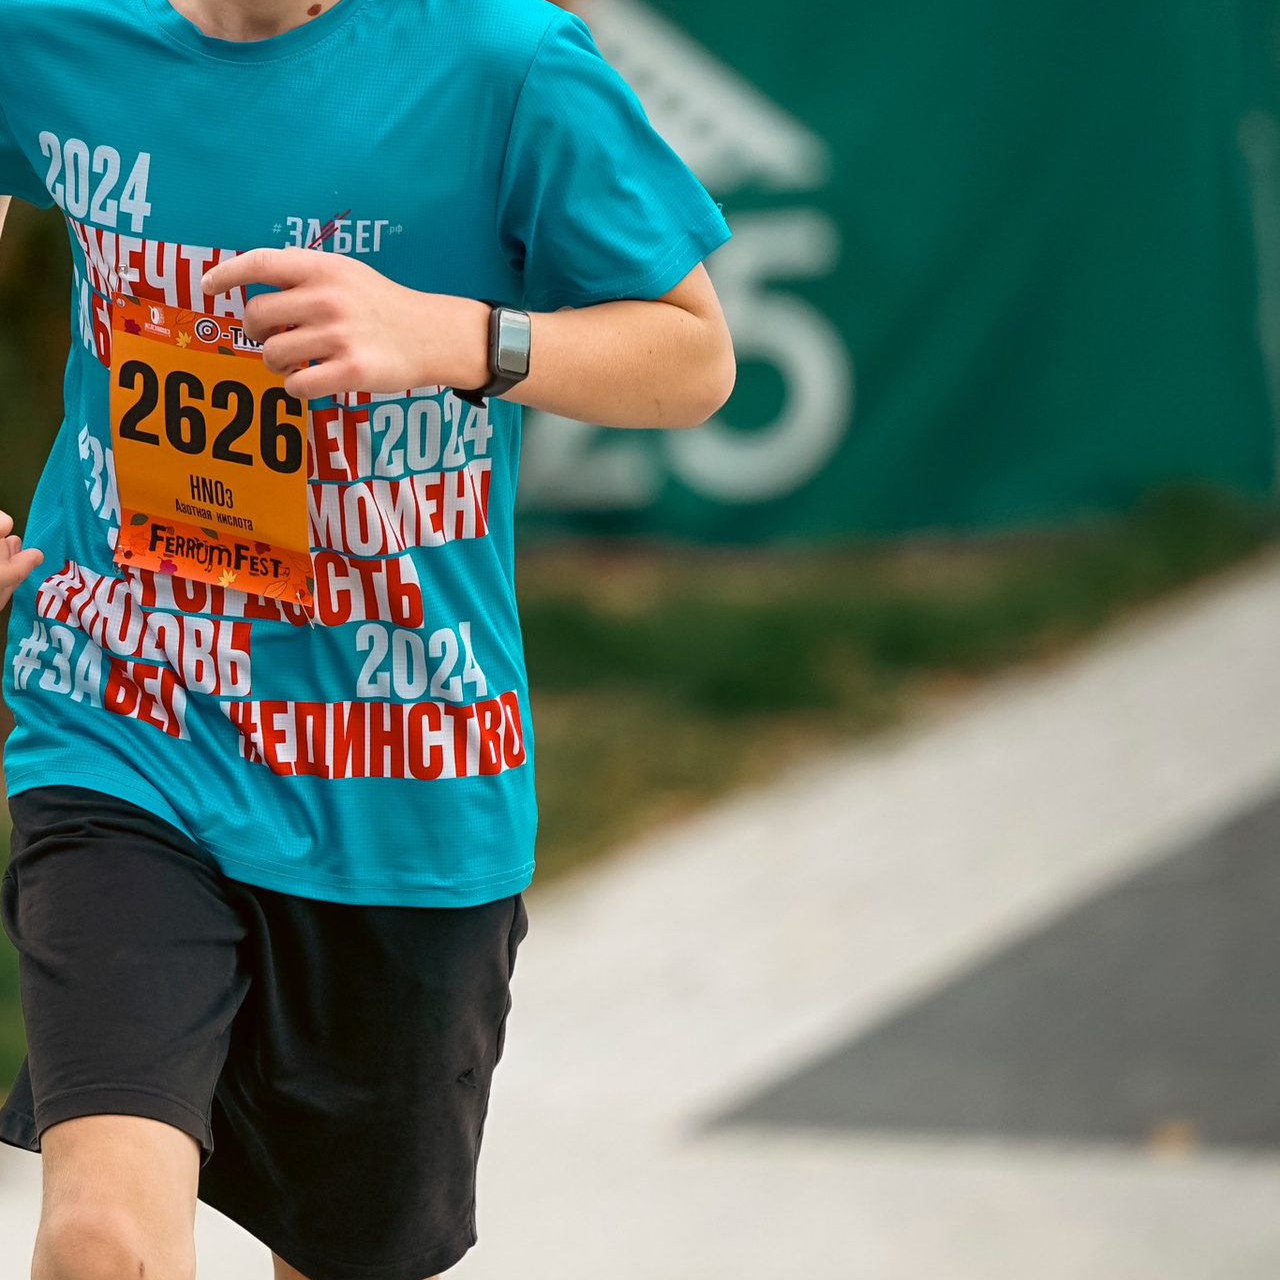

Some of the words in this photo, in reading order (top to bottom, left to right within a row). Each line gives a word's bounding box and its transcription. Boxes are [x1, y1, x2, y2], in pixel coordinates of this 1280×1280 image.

[39, 130, 151, 232] 2024
[118, 359, 303, 474] 2626
[372, 388, 493, 476] 2024
[175, 498, 213, 521] Азотная
[216, 511, 254, 532] кислота
[356, 622, 488, 702] 2024
